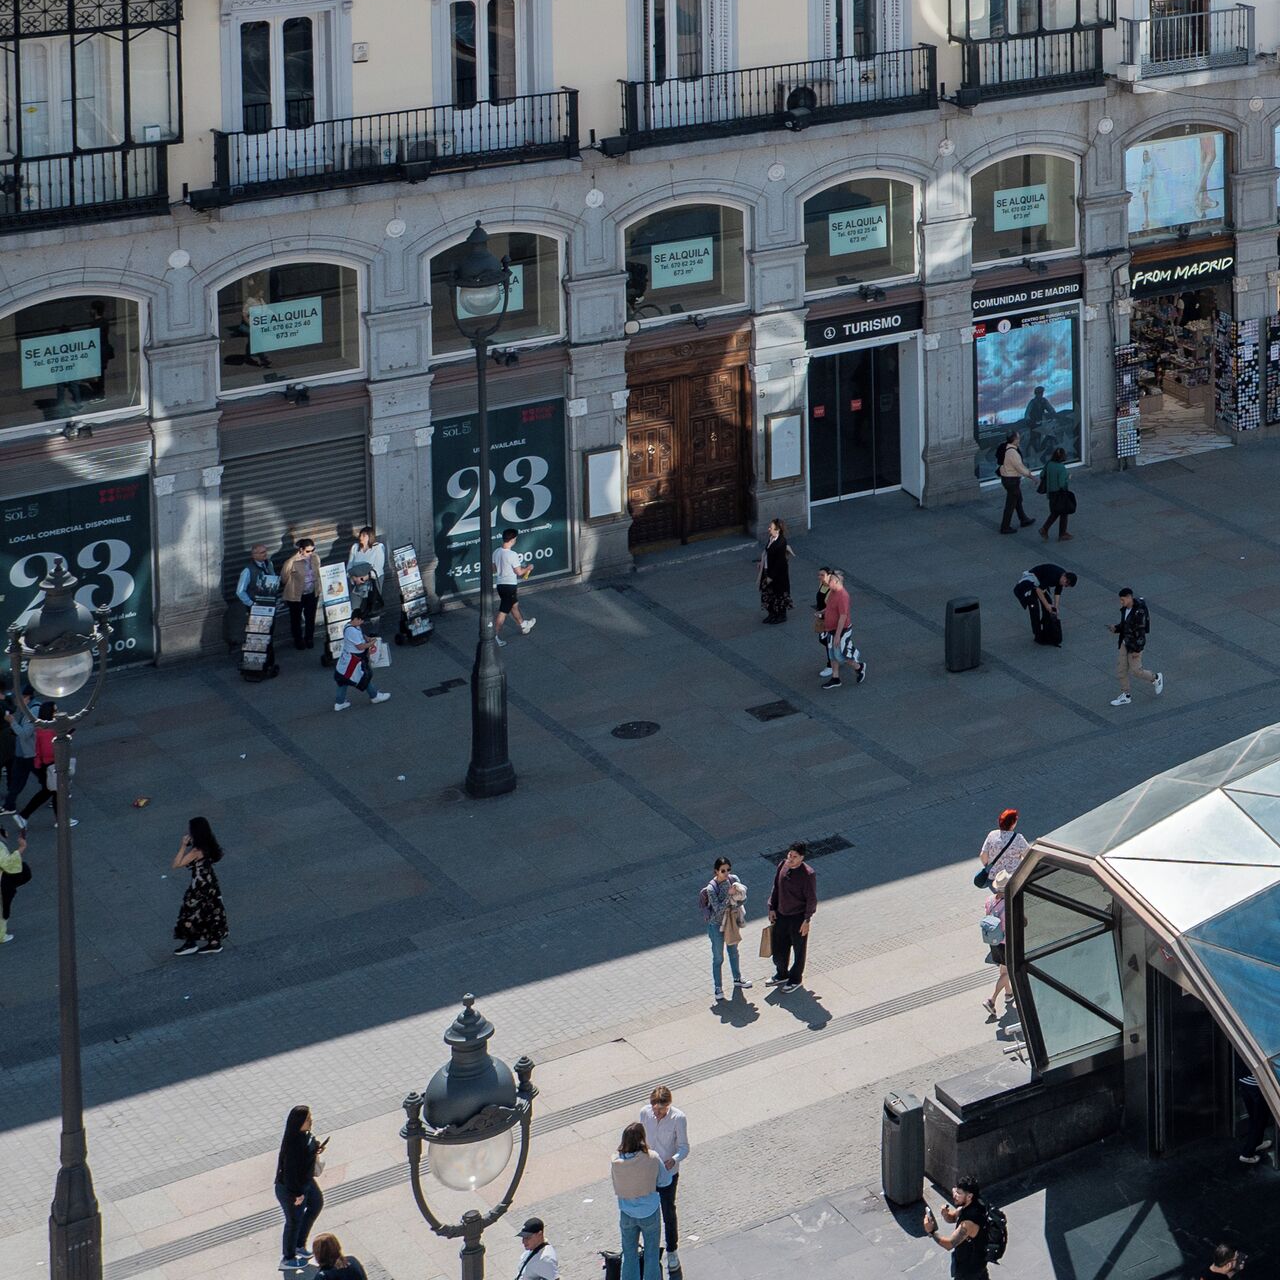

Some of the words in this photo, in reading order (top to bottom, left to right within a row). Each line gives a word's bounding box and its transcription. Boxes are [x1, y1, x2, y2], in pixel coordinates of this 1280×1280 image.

[997, 199, 1007, 207] SE
[1009, 193, 1045, 206] ALQUILA
[832, 222, 843, 231] SE
[845, 216, 883, 229] ALQUILA
[654, 254, 666, 263] SE
[669, 248, 709, 261] ALQUILA
[1132, 267, 1170, 290] FROM
[1175, 257, 1233, 280] MADRID
[973, 293, 1027, 309] COMUNIDAD
[1031, 290, 1043, 299] DE
[1045, 284, 1079, 296] MADRID
[253, 316, 267, 325] SE
[270, 308, 318, 323] ALQUILA
[843, 315, 901, 335] TURISMO
[25, 348, 40, 359] SE
[44, 340, 96, 356] ALQUILA
[50, 365, 64, 373] 673
[442, 428, 461, 438] SOL
[490, 439, 526, 451] AVAILABLE
[446, 455, 552, 536] 23
[4, 509, 27, 522] SOL
[9, 533, 36, 543] LOCAL
[37, 524, 84, 538] COMERCIAL
[85, 515, 131, 529] DISPONIBLE
[447, 565, 471, 579] +34
[535, 547, 553, 559] 00
[115, 637, 136, 651] 00
